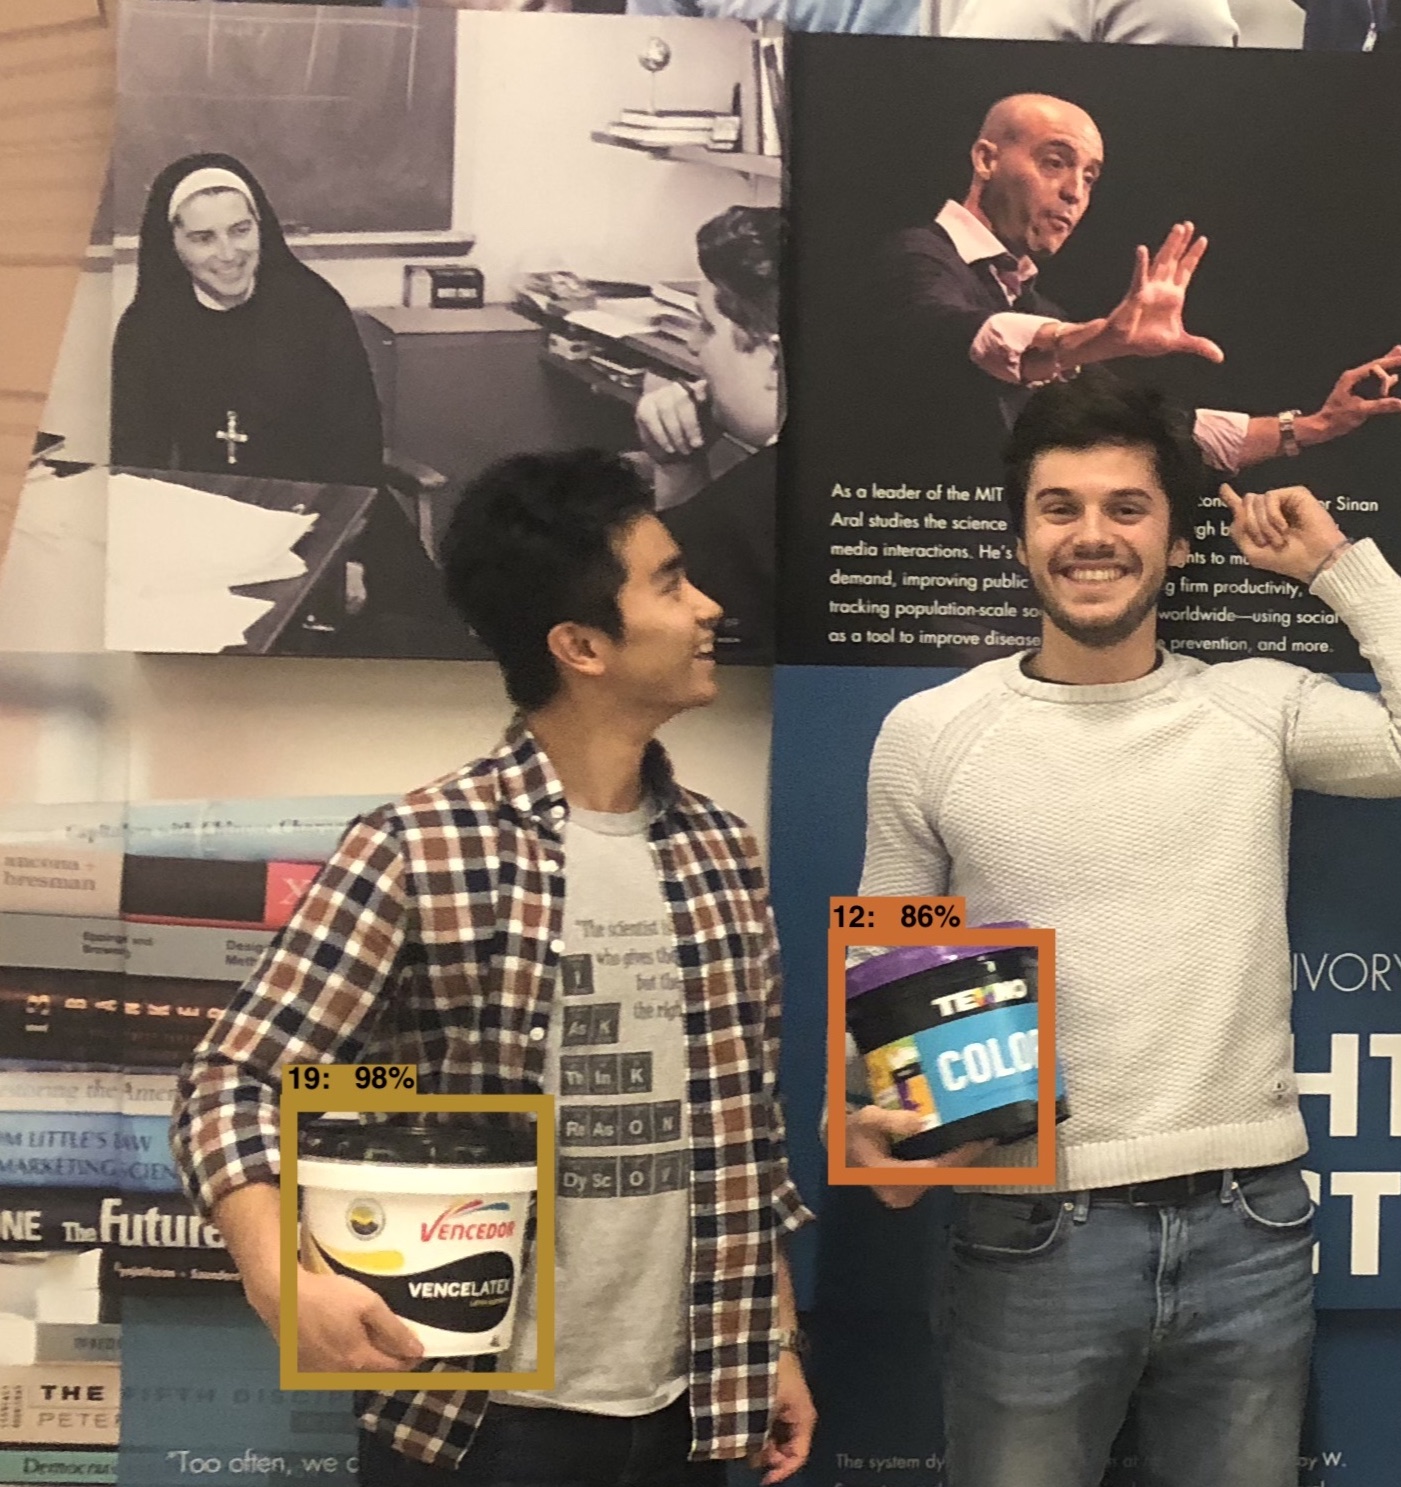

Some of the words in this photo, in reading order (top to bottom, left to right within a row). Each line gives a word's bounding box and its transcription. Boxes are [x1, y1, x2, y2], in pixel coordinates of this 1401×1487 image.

[831, 483, 851, 499] As
[856, 487, 867, 499] a
[872, 483, 921, 500] leader
[926, 484, 944, 500] of
[946, 484, 970, 501] the
[975, 486, 1004, 501] MIT
[1336, 496, 1379, 512] Sinan
[830, 511, 863, 528] Aral
[868, 511, 919, 529] studies
[924, 513, 947, 529] the
[951, 513, 1007, 531] science
[830, 541, 878, 557] media
[883, 541, 973, 559] interactions.
[979, 544, 1012, 560] He's
[1211, 553, 1225, 566] to
[829, 569, 897, 588] demand,
[902, 572, 977, 592] improving
[982, 572, 1029, 590] public
[1180, 576, 1209, 593] firm
[1214, 579, 1303, 599] productivity,
[829, 599, 889, 618] tracking
[895, 600, 1017, 619] population-scale
[1296, 608, 1339, 625] social
[828, 631, 846, 643] as
[851, 632, 862, 643] a
[867, 628, 895, 644] tool
[900, 630, 914, 644] to
[919, 630, 979, 648] improve
[984, 631, 1041, 647] disease
[1170, 635, 1250, 655] prevention,
[1257, 635, 1287, 651] and
[1291, 640, 1334, 653] more.
[61, 1221, 97, 1242] The
[40, 1385, 104, 1401] THE
[228, 1448, 292, 1476] often,
[302, 1456, 338, 1473] we
[836, 1453, 863, 1469] The
[869, 1455, 920, 1473] system
[1322, 1452, 1347, 1467] W.
